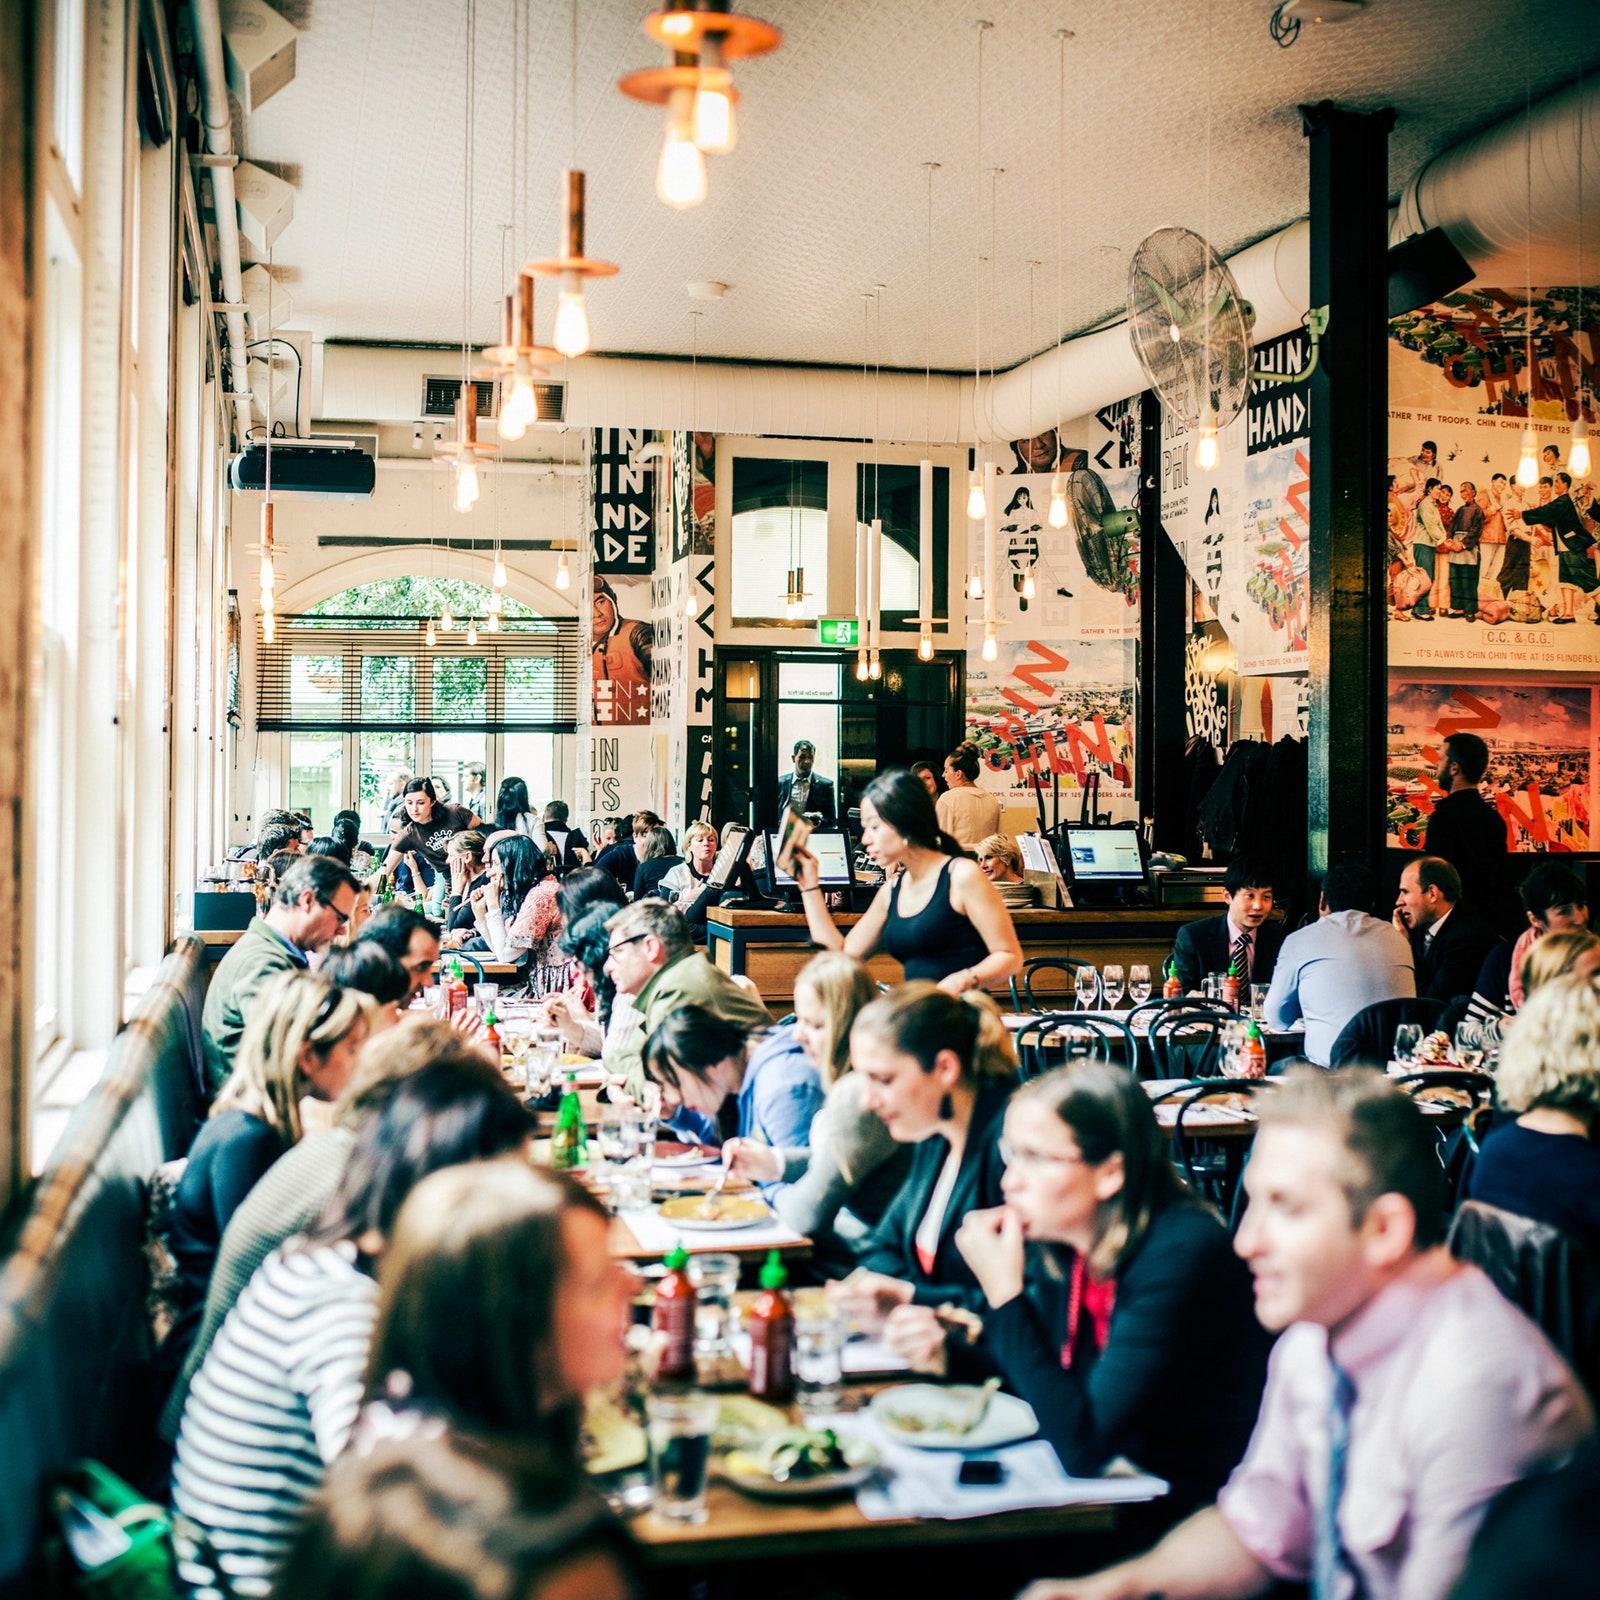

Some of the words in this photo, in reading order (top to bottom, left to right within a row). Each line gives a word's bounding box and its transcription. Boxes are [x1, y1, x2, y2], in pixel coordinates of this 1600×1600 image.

[1248, 393, 1306, 446] HAND
[1417, 413, 1433, 421] THE
[1437, 415, 1472, 425] TROOPS.
[1476, 418, 1496, 427] CHIN
[1500, 420, 1520, 429] CHIN
[1524, 423, 1552, 432] ETERY
[1557, 426, 1571, 434] 125
[594, 502, 650, 531] ND
[594, 533, 648, 563] DE
[1487, 631, 1510, 643] C.C.
[1514, 632, 1523, 643] &
[1527, 632, 1551, 644] G.G.
[1416, 649, 1432, 658] IT'S
[1434, 650, 1465, 659] ALWAYS
[1467, 650, 1486, 659] CHIN
[1488, 651, 1508, 660] CHIN
[1510, 652, 1528, 661] TIME
[1530, 653, 1539, 661] AT
[1542, 653, 1555, 662] 125
[1557, 654, 1593, 663] FLINDERS
[592, 679, 632, 699] IN
[592, 701, 632, 721] IN
[985, 713, 1114, 780] CHIN
